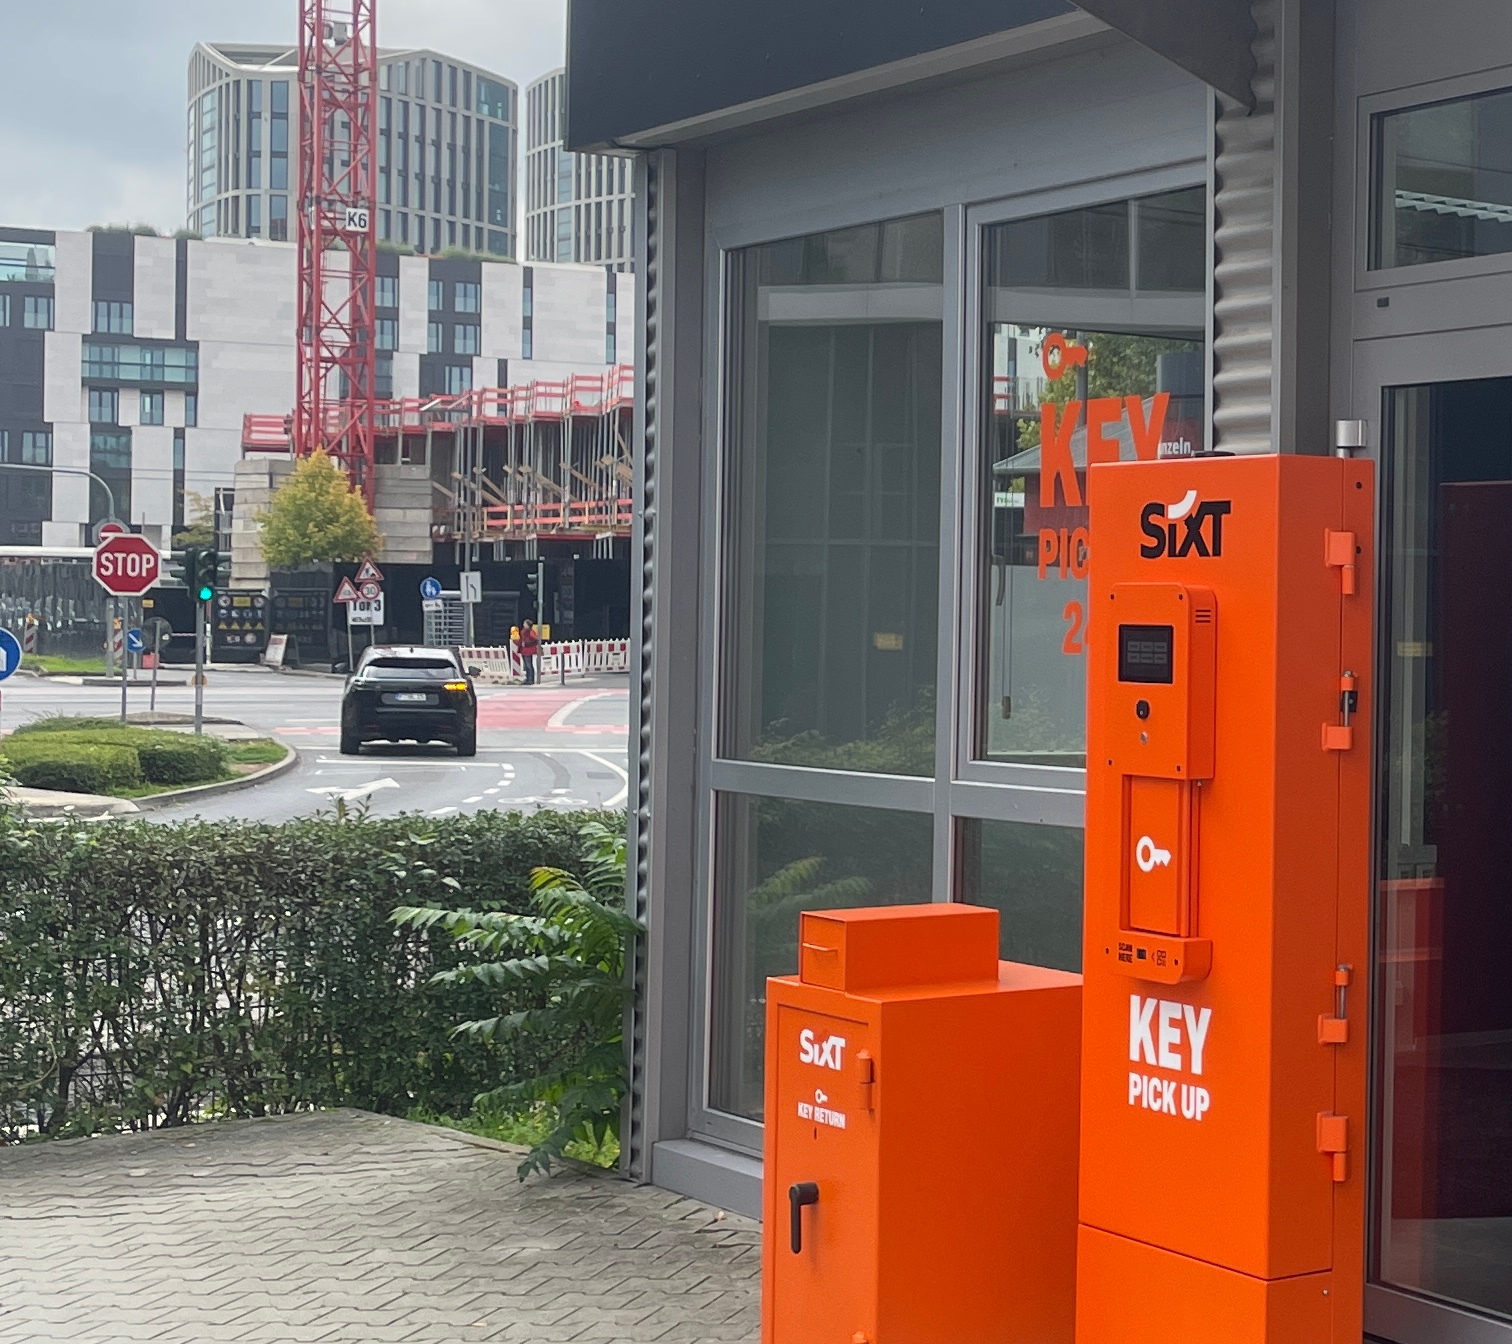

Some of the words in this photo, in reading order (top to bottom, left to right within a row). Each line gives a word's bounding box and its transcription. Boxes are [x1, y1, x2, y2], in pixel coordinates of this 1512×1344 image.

[347, 210, 368, 229] K6
[1039, 392, 1170, 507] KEY
[1160, 437, 1195, 457] nzeln,
[1140, 489, 1231, 559] SIXT
[100, 552, 155, 577] STOP
[1038, 527, 1089, 580] PIC
[374, 600, 381, 612] 3
[1063, 600, 1089, 655] 2
[799, 1028, 846, 1071] SIXT
[1129, 994, 1212, 1075] KEY
[797, 1101, 813, 1120] KEY
[814, 1106, 846, 1130] RETURN
[1128, 1072, 1177, 1116] PICK
[1181, 1083, 1210, 1122] UP
